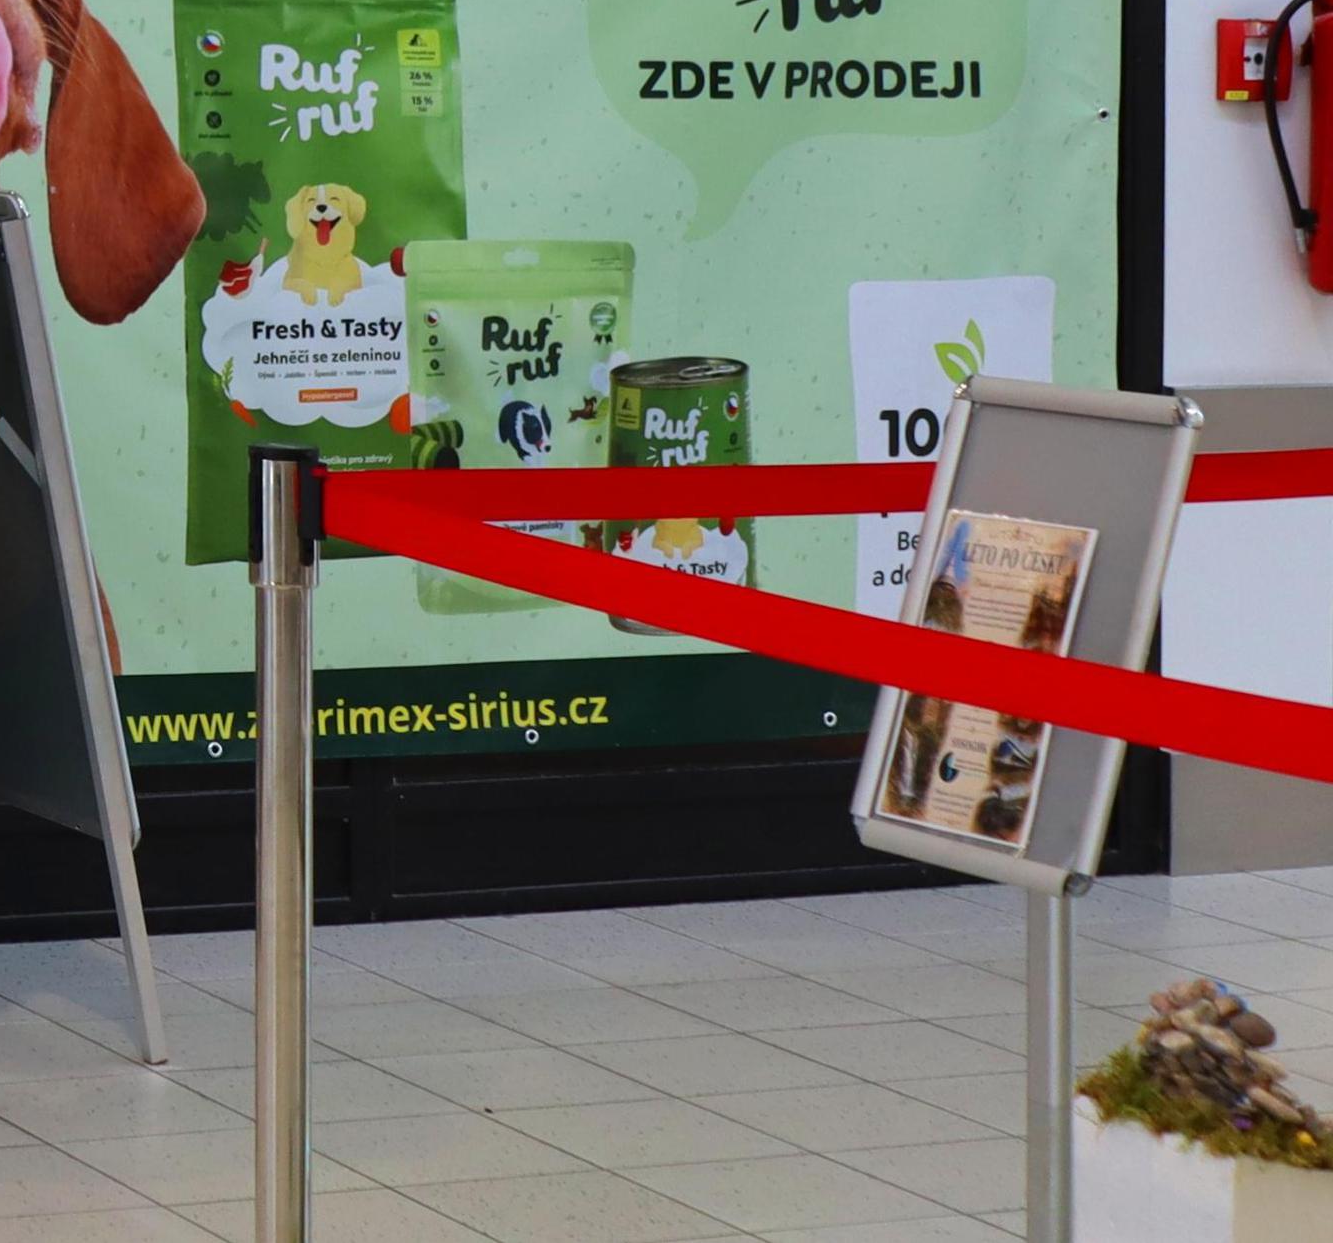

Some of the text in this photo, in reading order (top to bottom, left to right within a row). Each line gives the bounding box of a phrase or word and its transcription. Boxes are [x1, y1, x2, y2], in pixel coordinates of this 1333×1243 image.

[260, 44, 363, 94] Ruf
[638, 59, 982, 99] ZDE V PRODEJI
[297, 80, 379, 142] ruf
[252, 317, 402, 341] Fresh & Tasty
[482, 315, 554, 352] Ruf
[252, 348, 401, 366] Jehněčí se zeleninou
[506, 342, 563, 385] ruf
[644, 407, 702, 440] Ruf
[662, 430, 709, 468] ruf
[689, 560, 728, 576] Tasty
